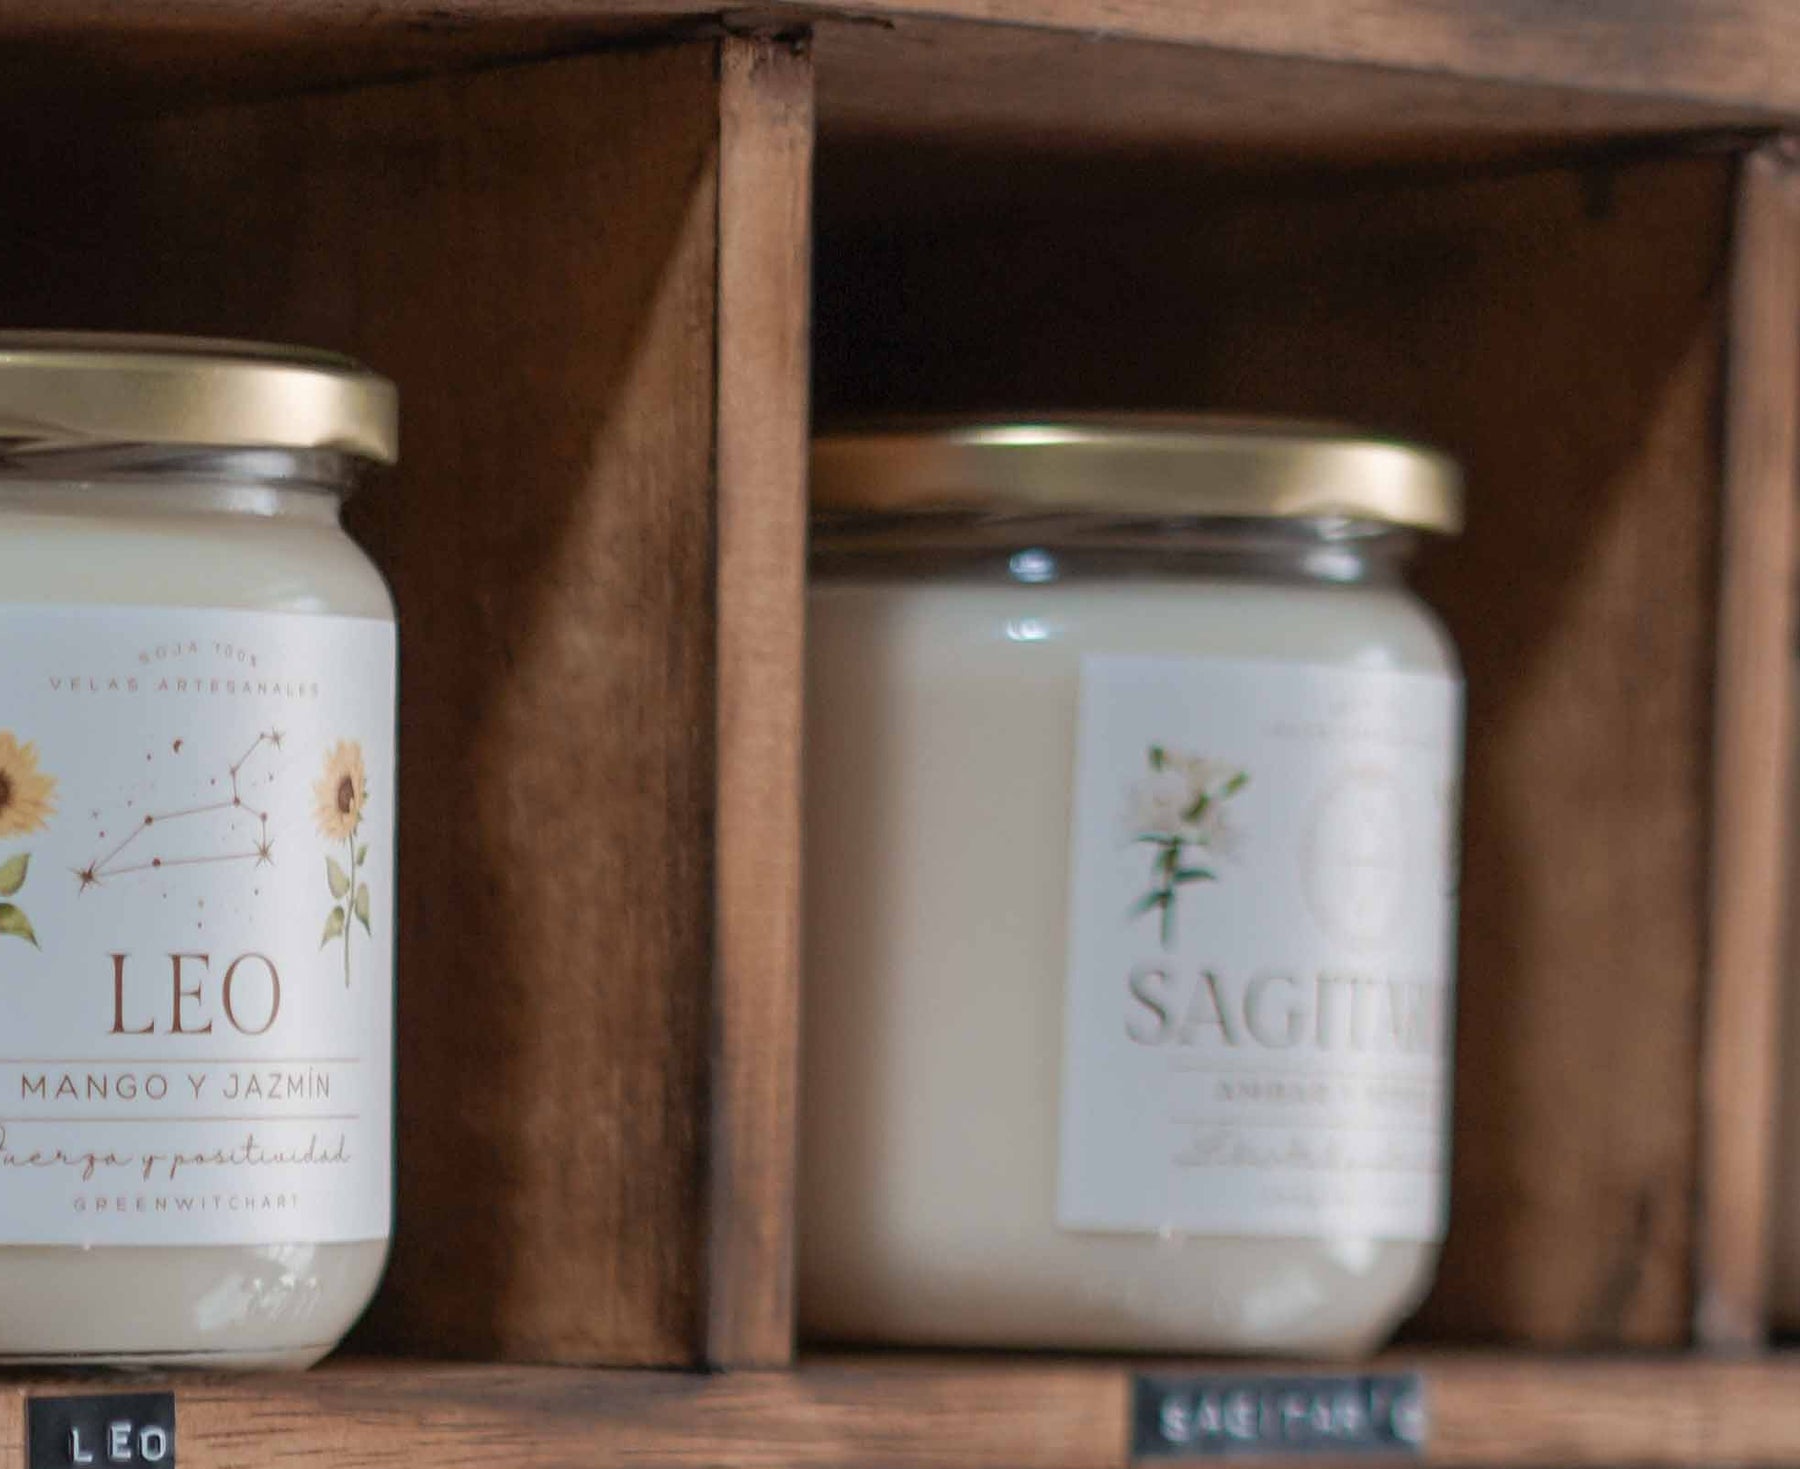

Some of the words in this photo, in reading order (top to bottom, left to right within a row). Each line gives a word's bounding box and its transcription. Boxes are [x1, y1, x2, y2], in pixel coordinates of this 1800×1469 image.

[49, 676, 138, 693] VELAS
[157, 676, 320, 698] ARTESANALES
[108, 952, 282, 1036] LEO
[21, 1073, 168, 1101] MANGO
[187, 1073, 207, 1100] Y
[222, 1066, 331, 1100] JAZMÍN
[166, 1133, 351, 1182] positividad
[72, 1193, 299, 1213] GREENWITCHART
[70, 1420, 168, 1463] LEO
